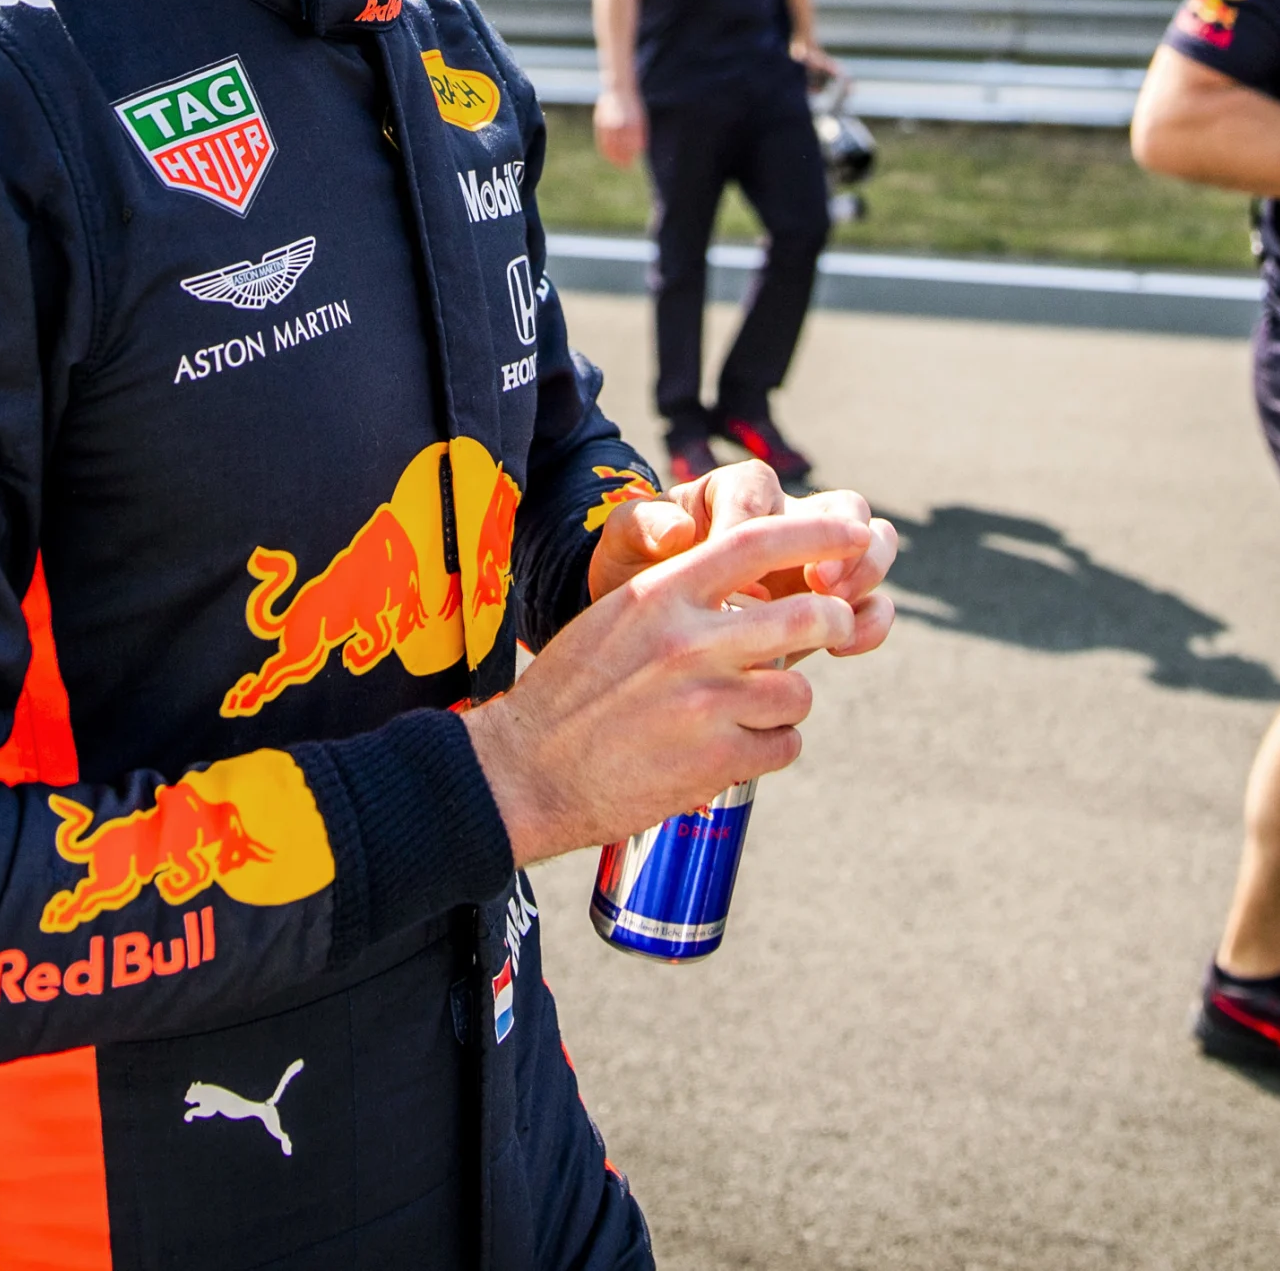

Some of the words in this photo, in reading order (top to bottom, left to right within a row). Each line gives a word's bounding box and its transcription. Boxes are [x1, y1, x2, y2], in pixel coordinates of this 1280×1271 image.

[132, 75, 247, 139] TAG
[160, 124, 266, 201] HEUER
[457, 162, 522, 223] Mobil
[173, 331, 267, 385] ASTON
[274, 298, 353, 351] MARTIN
[500, 350, 538, 392] HON
[111, 905, 216, 989] Bull
